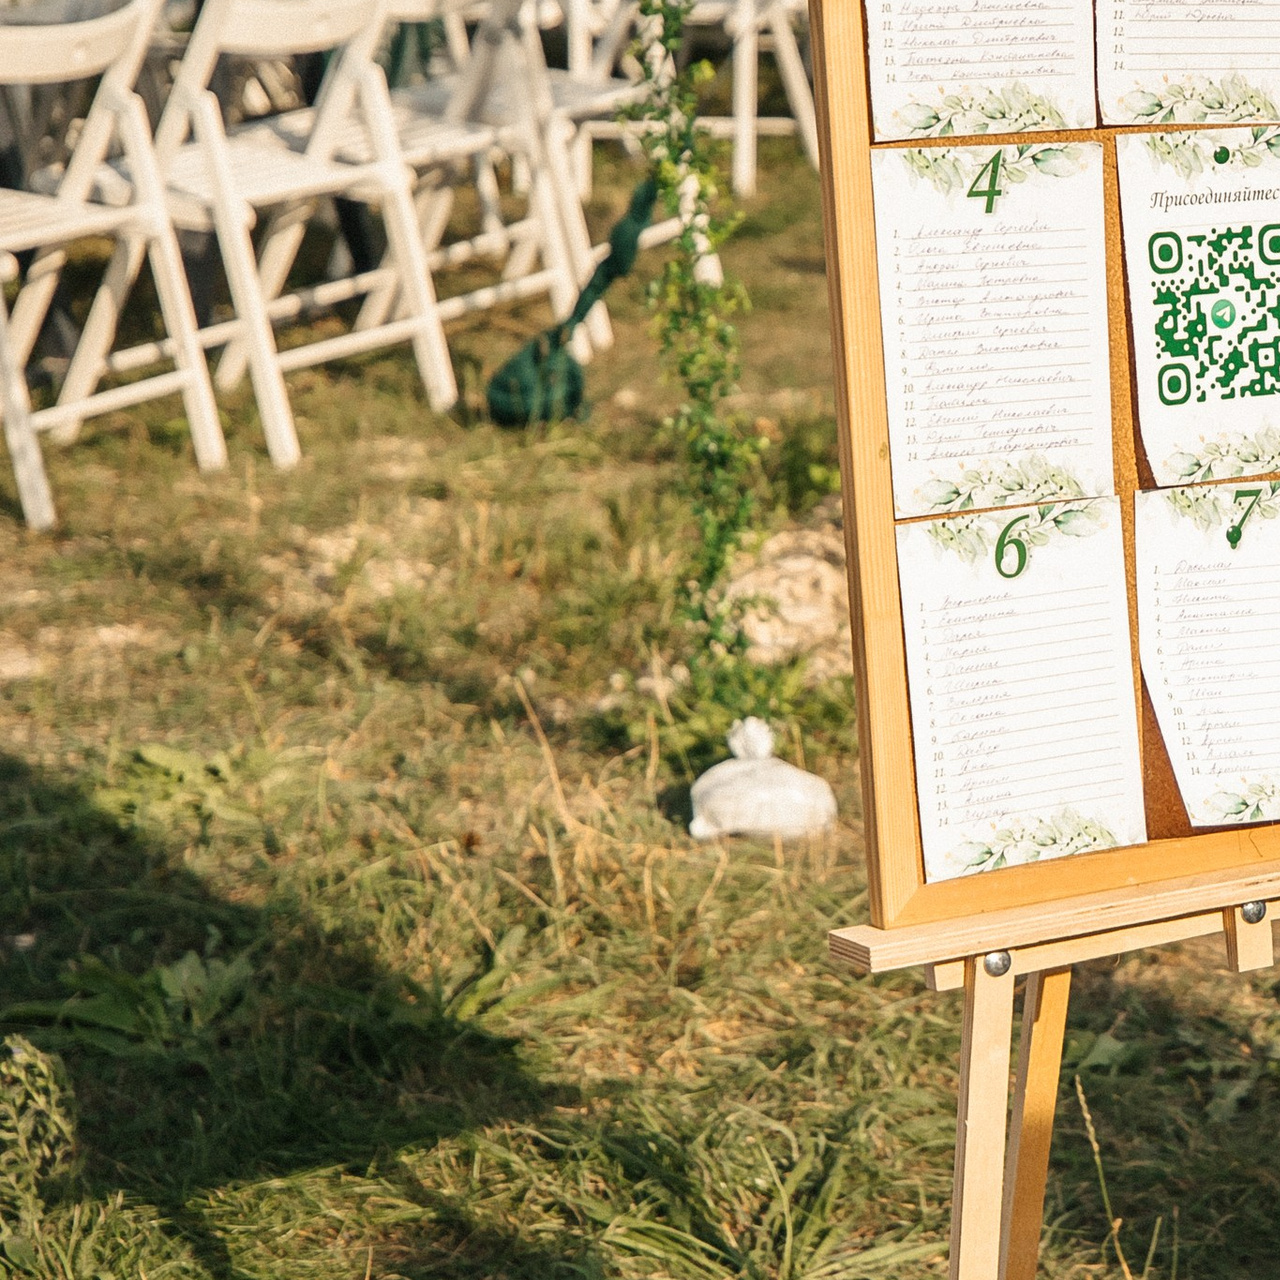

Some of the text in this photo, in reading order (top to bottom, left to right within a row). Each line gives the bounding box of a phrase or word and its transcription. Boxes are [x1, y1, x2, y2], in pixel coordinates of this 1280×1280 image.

[1114, 10, 1125, 19] 11.
[1114, 27, 1125, 36] 12.
[1114, 44, 1125, 53] 13.
[1114, 61, 1125, 70] 14.
[967, 148, 1003, 214] 4
[1226, 489, 1262, 549] 7
[995, 514, 1030, 578] 6
